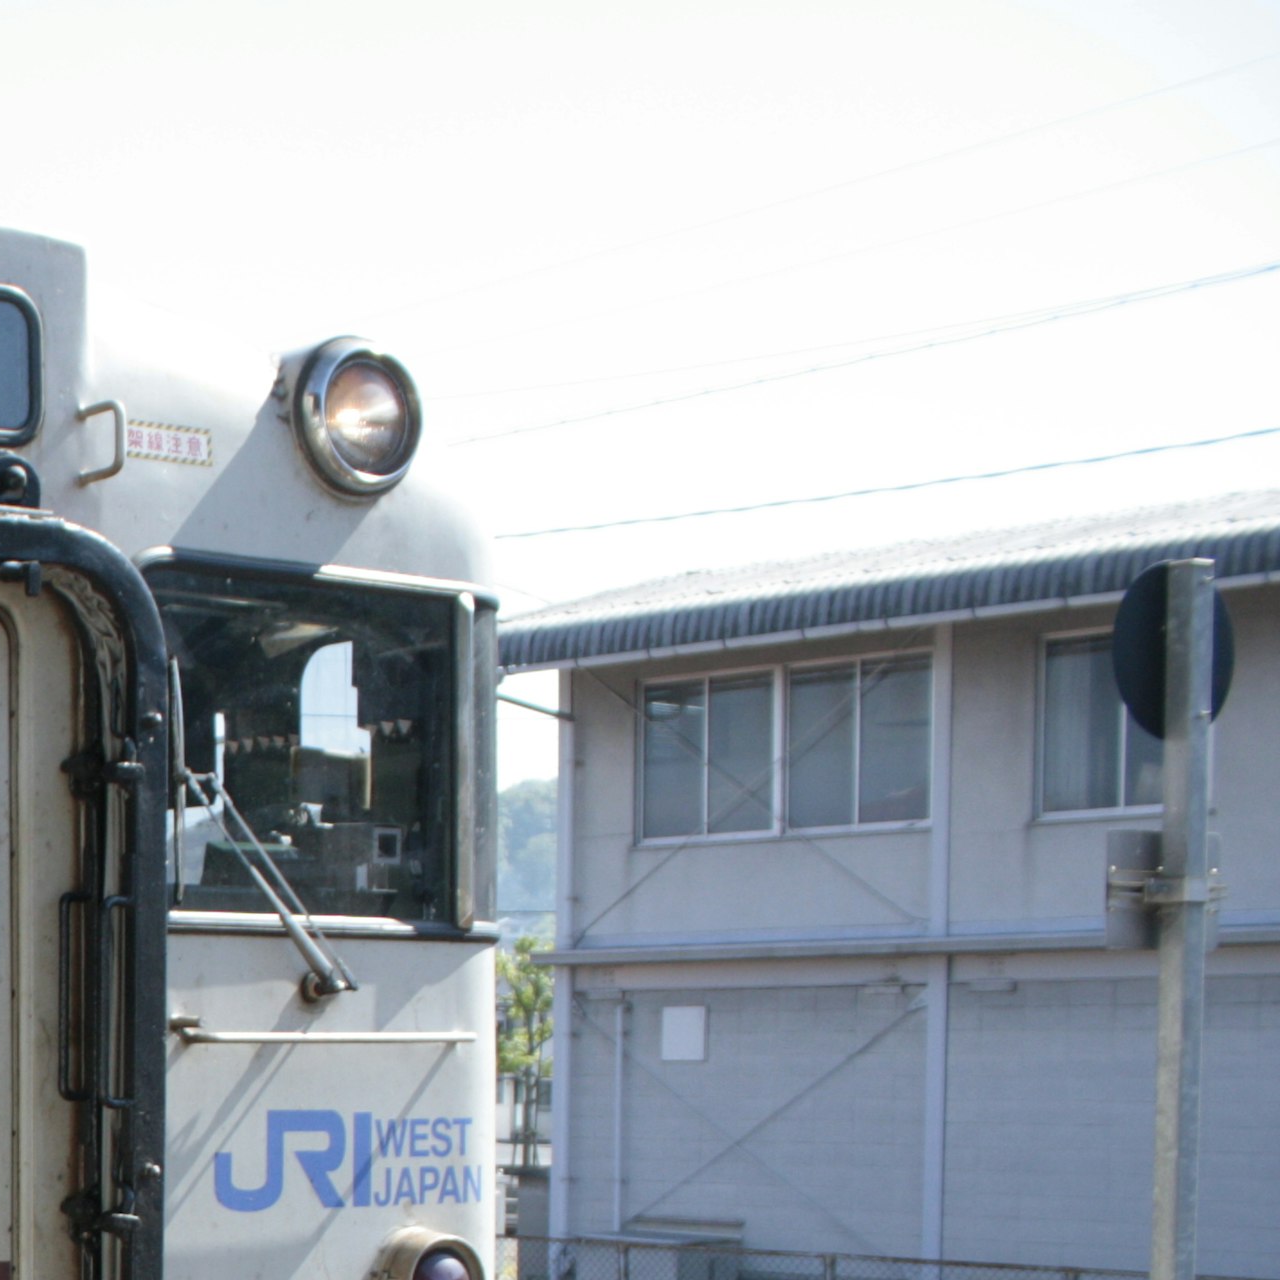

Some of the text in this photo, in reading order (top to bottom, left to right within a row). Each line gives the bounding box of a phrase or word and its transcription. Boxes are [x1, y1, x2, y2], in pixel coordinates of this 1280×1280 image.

[127, 428, 203, 457] 架線注意
[375, 1117, 472, 1157] WEST
[374, 1165, 482, 1206] JAPAN
